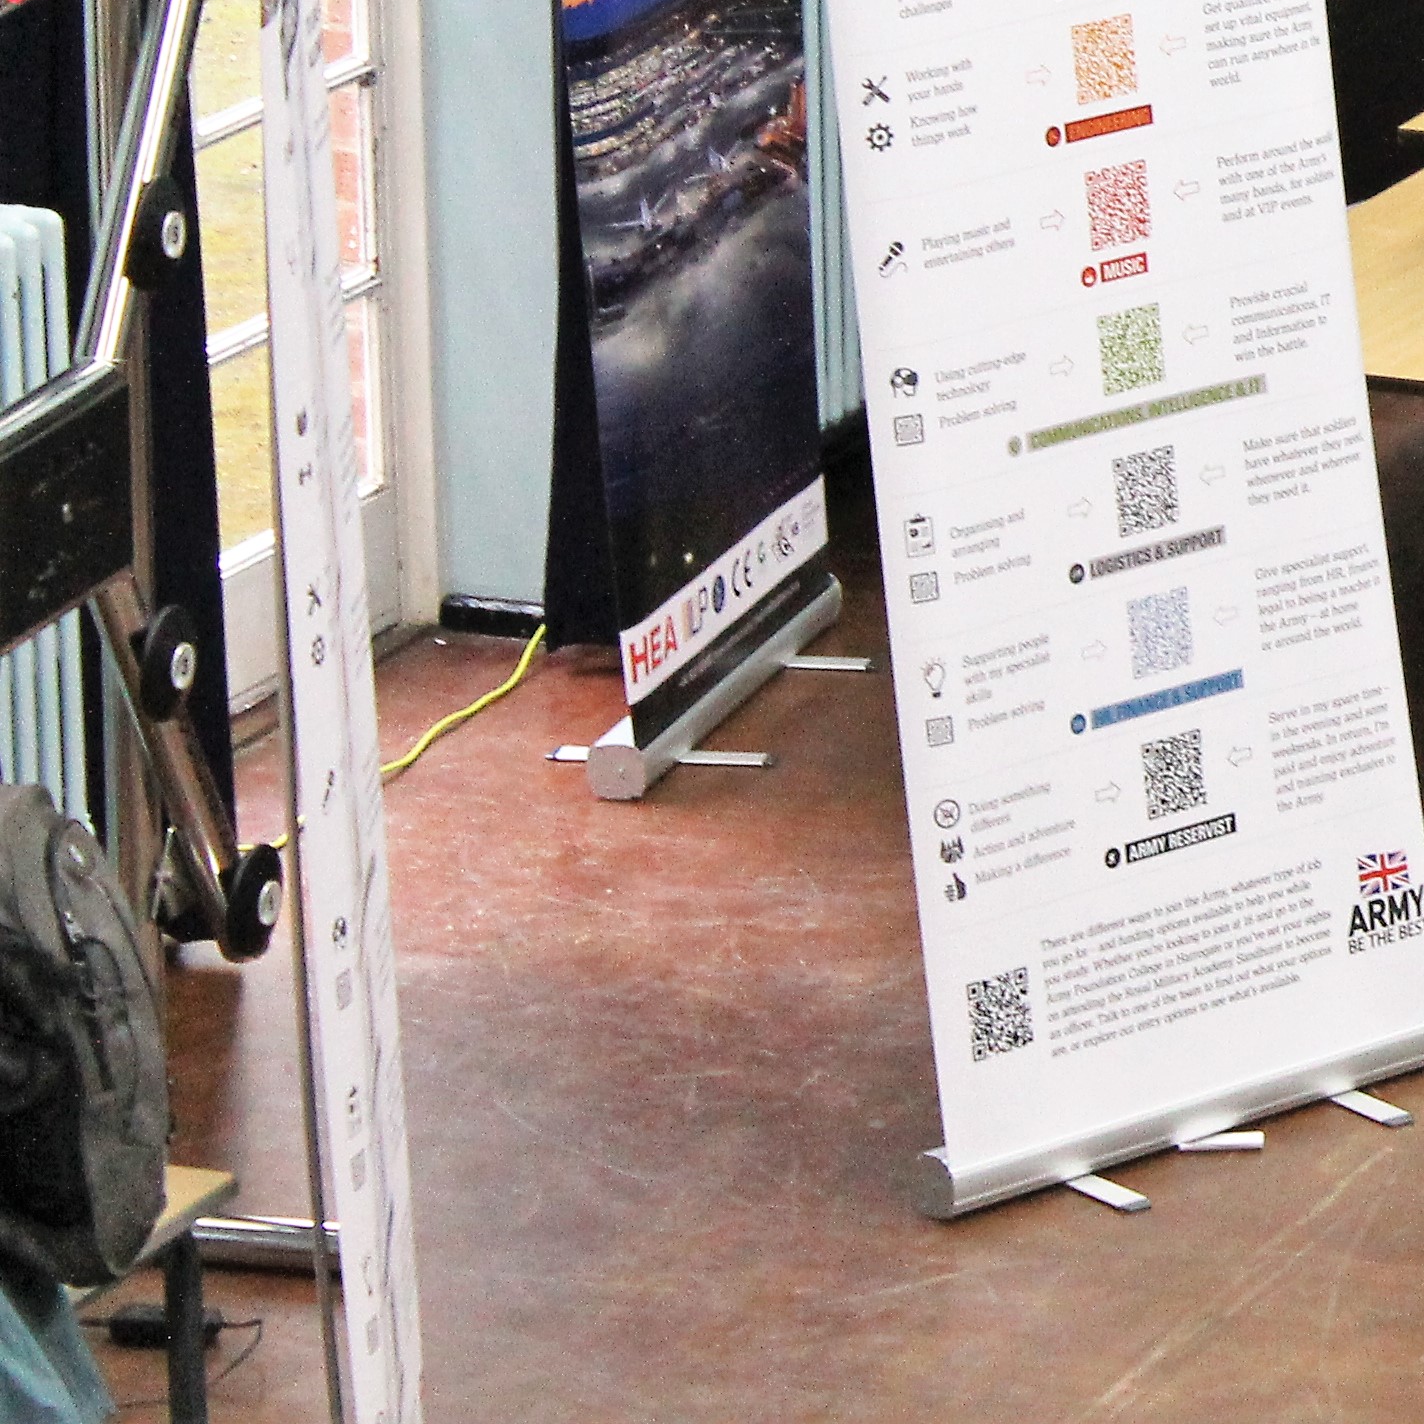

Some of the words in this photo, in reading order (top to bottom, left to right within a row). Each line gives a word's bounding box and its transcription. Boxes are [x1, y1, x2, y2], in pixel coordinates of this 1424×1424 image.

[1202, 0, 1221, 15] Get
[1206, 34, 1246, 53] making
[1216, 148, 1259, 169] Perform
[1261, 140, 1297, 159] around
[1221, 207, 1242, 222] and
[1257, 199, 1278, 215] VIP
[1103, 254, 1145, 280] MUSIC
[1229, 288, 1270, 310] Provide
[1272, 280, 1308, 300] crucial
[1232, 329, 1253, 345] and
[1257, 342, 1274, 357] the
[1243, 433, 1272, 452] Make
[1090, 547, 1151, 578] LOGISTICS
[1166, 528, 1223, 557] SUPPORT
[1128, 837, 1166, 862] ARMY
[1167, 815, 1234, 849] RESERVIST
[1348, 936, 1365, 954] BE
[1368, 927, 1395, 948] THE
